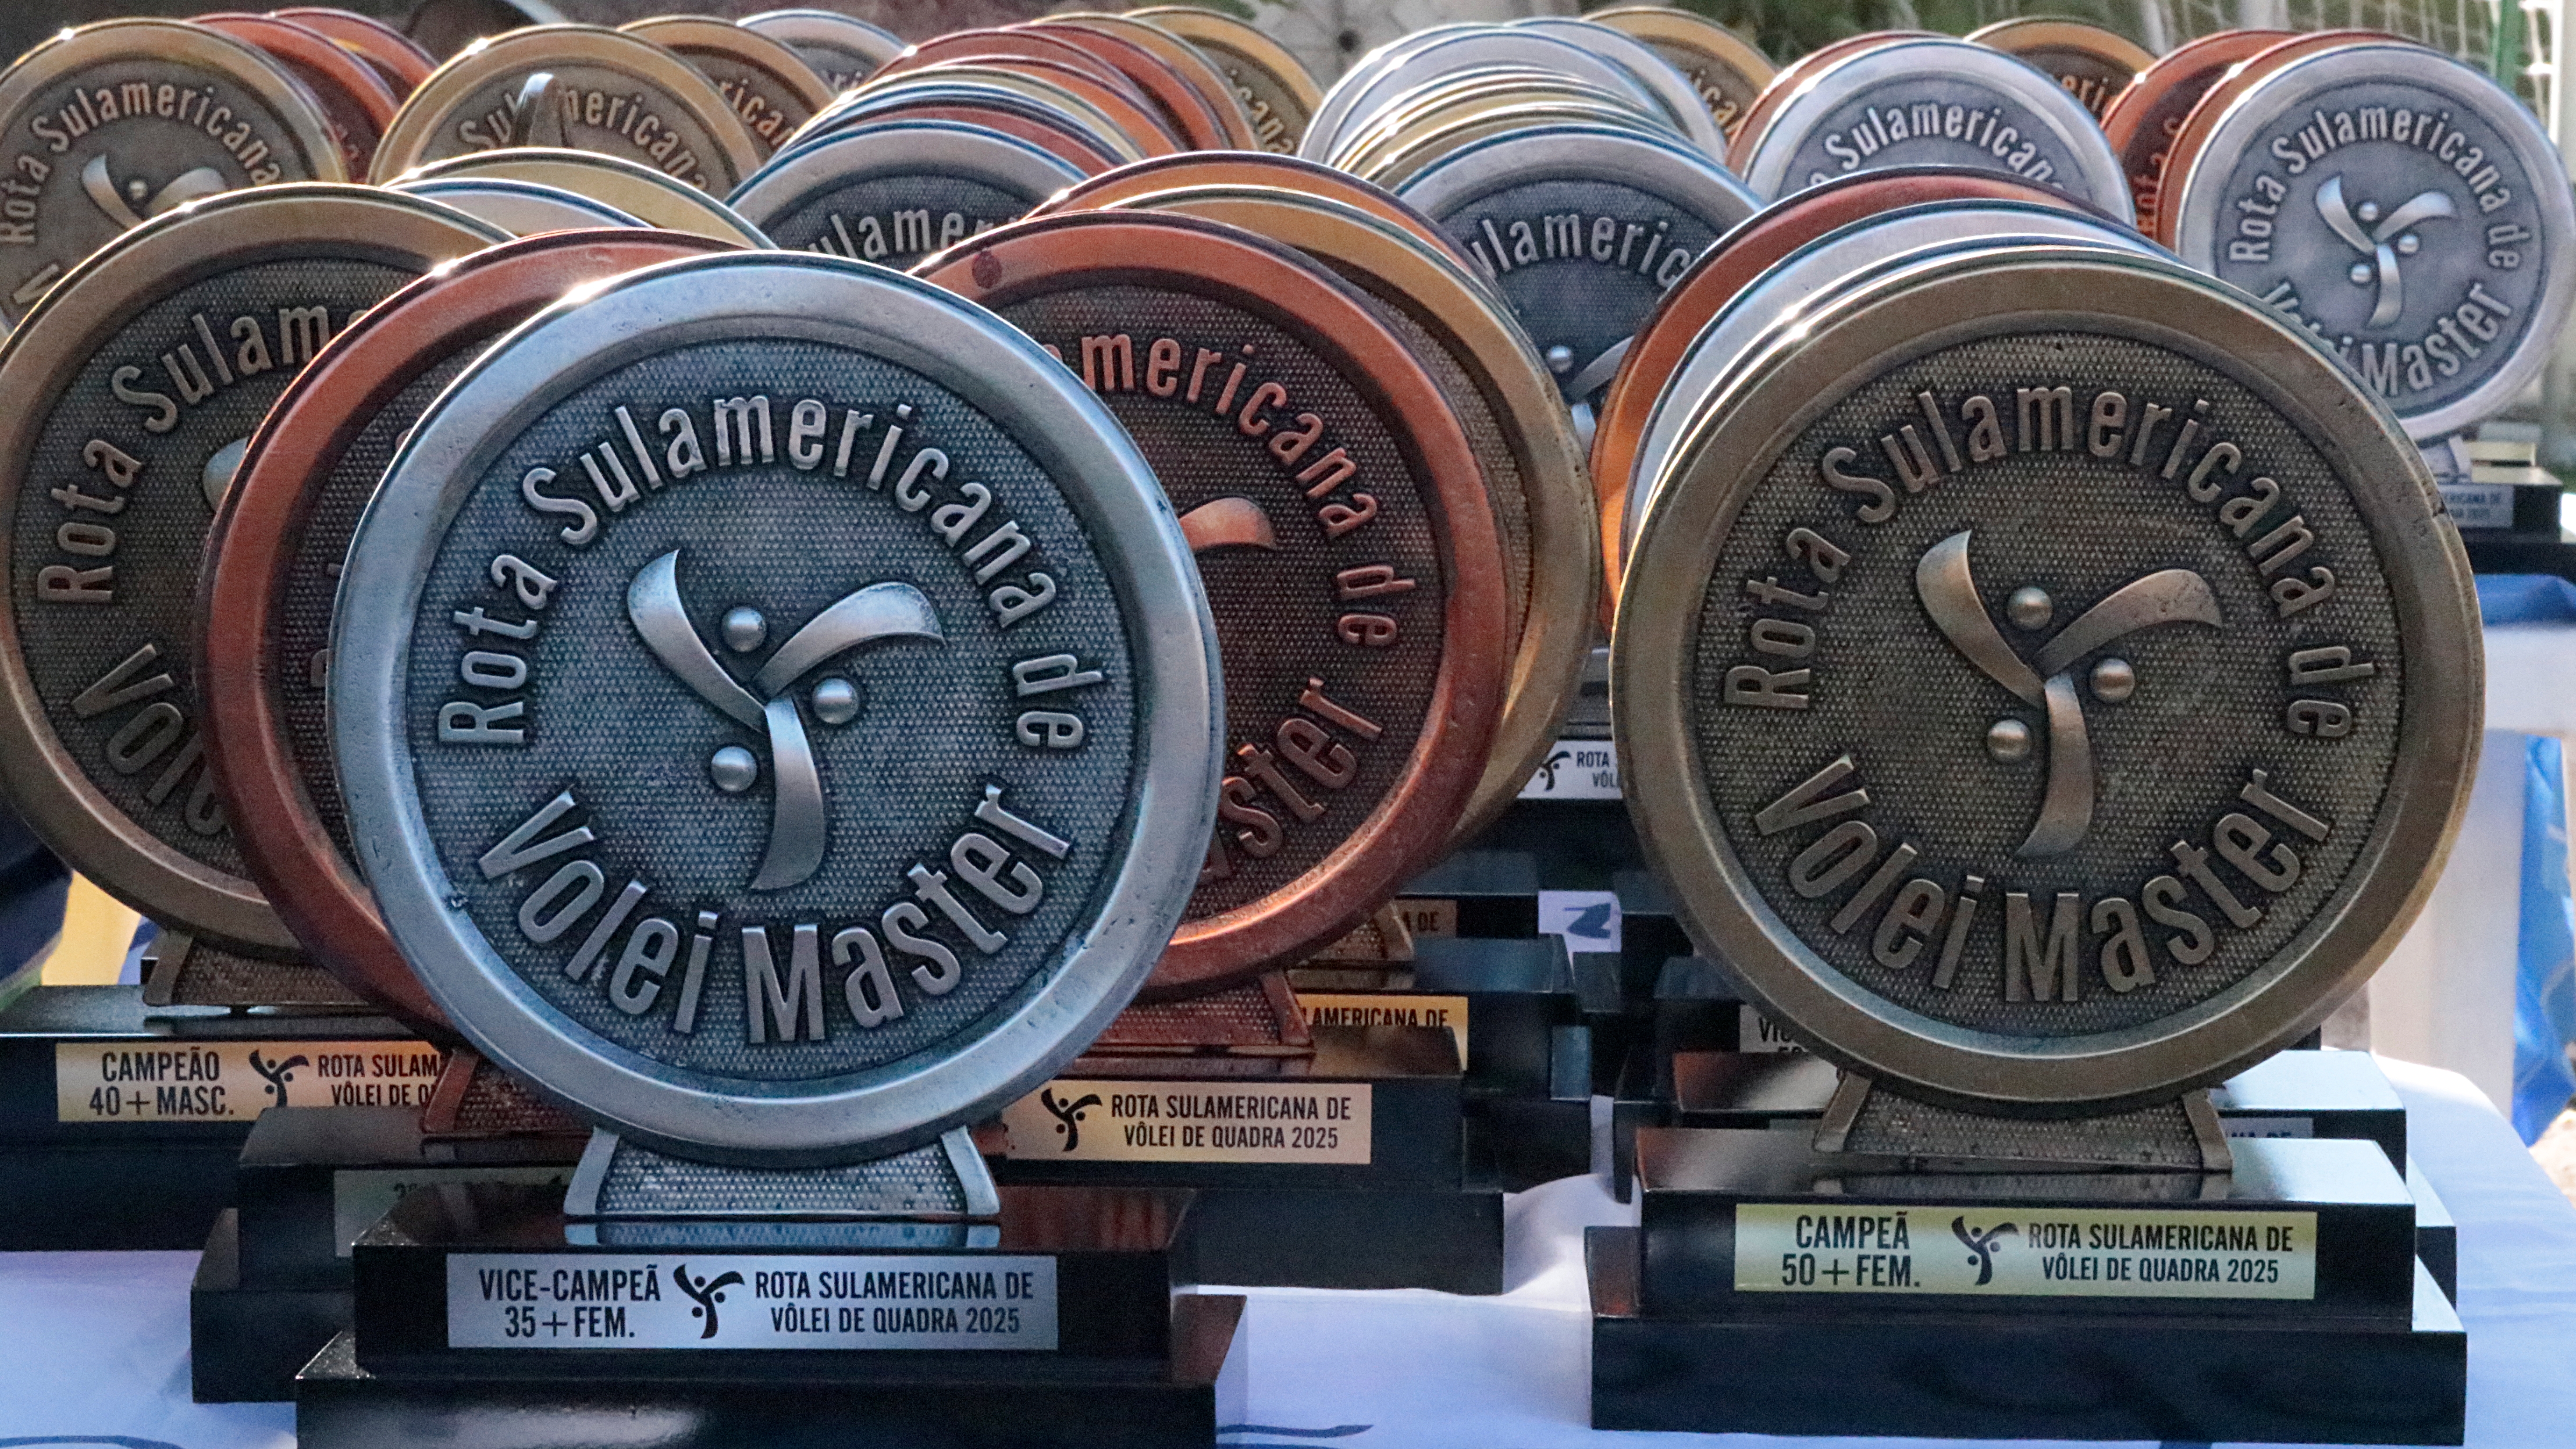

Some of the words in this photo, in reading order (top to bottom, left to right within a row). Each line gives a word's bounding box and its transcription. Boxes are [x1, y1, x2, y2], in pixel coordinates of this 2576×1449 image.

[1825, 101, 2065, 190] Sulamerican
[0, 155, 50, 243] Rota
[2229, 174, 2286, 264] Rota
[2272, 107, 2511, 212] Sulamericana
[2487, 223, 2530, 269] de
[2362, 283, 2512, 395] Master
[1052, 333, 1378, 539] mericana
[1337, 565, 1416, 647] de
[37, 439, 143, 602] Rota
[439, 554, 558, 744] Rota
[522, 394, 1056, 628] Sulamericana
[1012, 653, 1103, 749] de
[1724, 527, 1851, 709] Rota
[1822, 386, 2335, 619] Sulamericana
[2287, 645, 2375, 738] de
[1577, 751, 1610, 767] ROTA
[1754, 754, 1985, 990] Volei
[2005, 768, 2330, 1003] Master
[478, 790, 719, 1034] Volei
[742, 783, 1071, 1044] Master
[102, 1047, 220, 1081] CAMPEÃO
[318, 1054, 365, 1078] ROTA
[389, 1084, 411, 1106] DE
[1112, 1094, 1159, 1118] ROTA
[1167, 1095, 1317, 1120] SULAMERICANA
[1327, 1097, 1351, 1121] DE
[1124, 1121, 1175, 1147] VÔLEI
[1182, 1126, 1204, 1147] DE
[1212, 1126, 1284, 1148] QUADRA
[1292, 1127, 1338, 1149] 2025
[1796, 1211, 1910, 1249] CAMPEÃ
[2028, 1223, 2081, 1249] ROTA
[2089, 1224, 2258, 1251] SULAMERICANA
[2266, 1226, 2293, 1252] DE
[478, 1264, 661, 1301] VICE-CAMPEÃ
[755, 1271, 811, 1299] ROTA
[818, 1271, 997, 1299] SULAMERICANA
[1005, 1271, 1034, 1299] DE
[2042, 1252, 2099, 1281] VÔLEI
[2106, 1257, 2131, 1281] DE
[2139, 1257, 2220, 1282] QUADRA
[2227, 1259, 2278, 1283] 2025
[770, 1302, 830, 1333] VÔLEI
[839, 1307, 865, 1333] DE
[873, 1307, 959, 1334] QUADRA
[966, 1307, 1020, 1333] 2025
